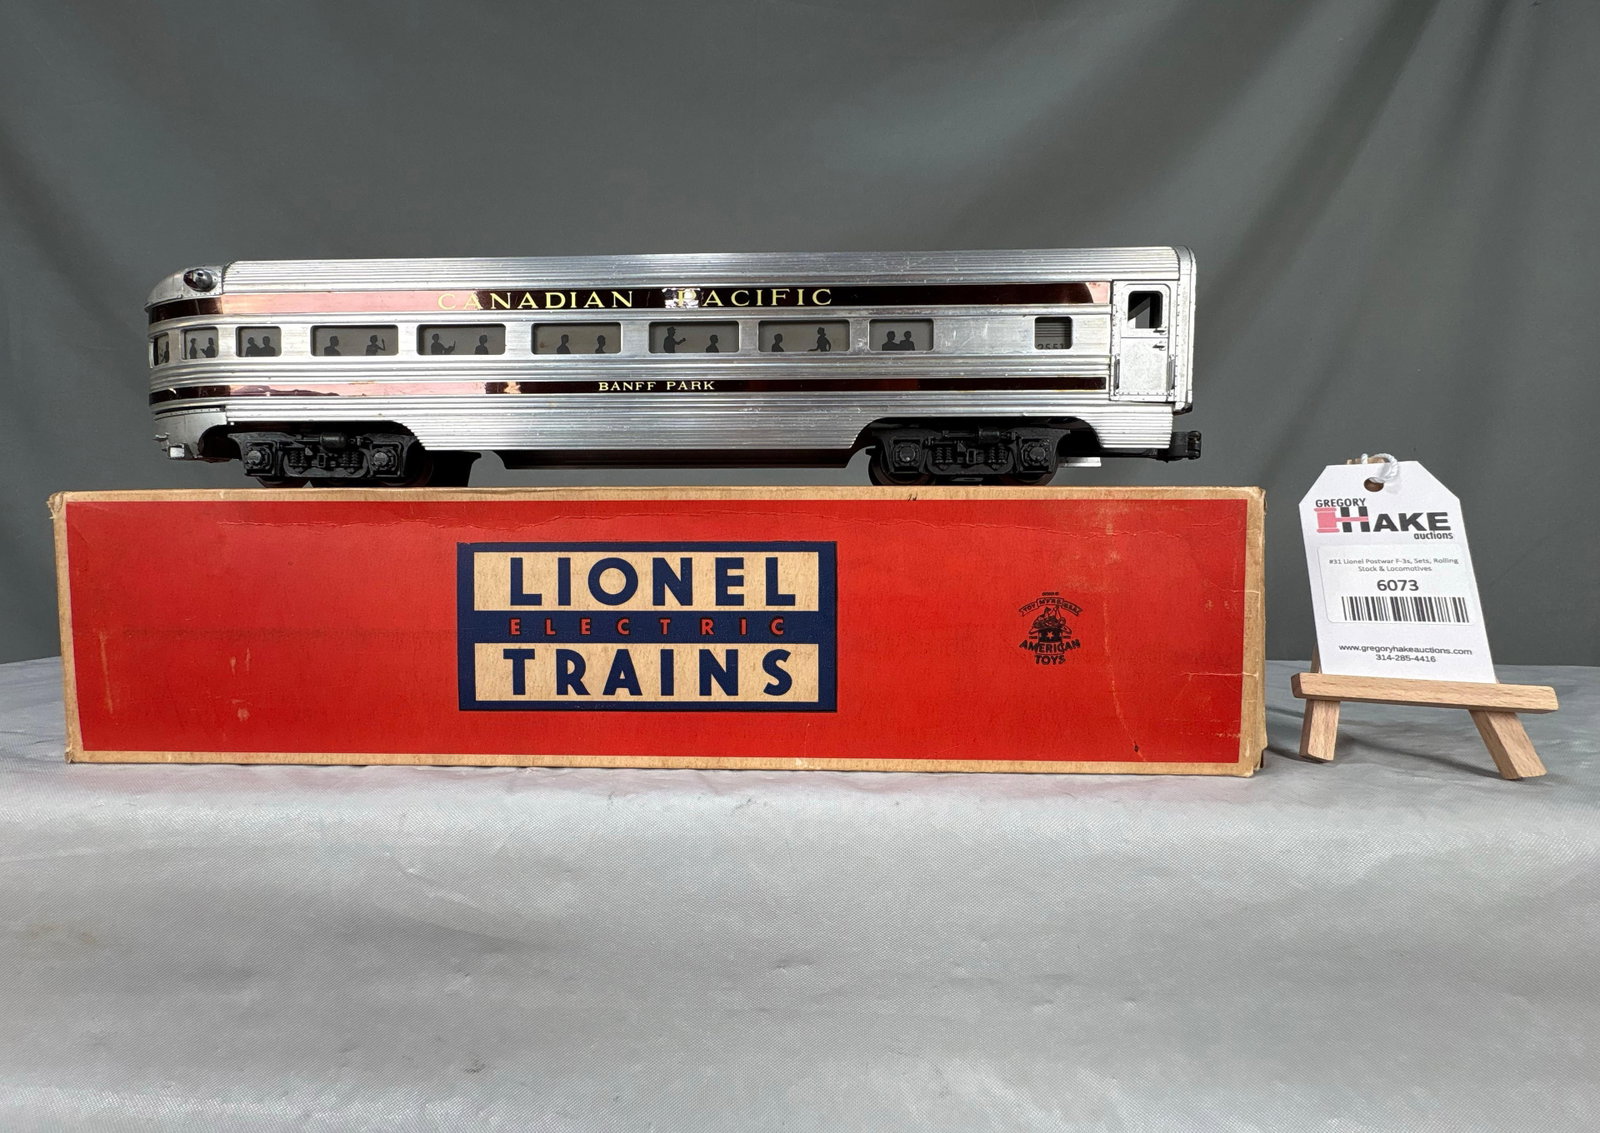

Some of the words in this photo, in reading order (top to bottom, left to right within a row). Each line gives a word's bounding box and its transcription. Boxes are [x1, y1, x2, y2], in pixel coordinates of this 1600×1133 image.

[437, 290, 633, 310] CANADIAN
[676, 288, 833, 308] PACIFIC
[598, 381, 657, 391] BANFF
[666, 381, 715, 391] PARK
[1315, 498, 1366, 507] GREGORY
[1340, 506, 1451, 532] HAKE
[1414, 531, 1454, 540] auctions
[1414, 558, 1432, 566] Sets,
[1433, 558, 1459, 566] Rolling
[509, 557, 796, 607] LIONEL
[1377, 579, 1419, 592] 6073
[510, 618, 786, 636] ELECTRIC
[1019, 639, 1081, 653] AMERICAN
[1338, 644, 1473, 656] www.gregoryhakeauctions.com
[1035, 654, 1066, 665] TOYS
[1375, 653, 1437, 663] 314-285-4416
[503, 649, 793, 696] TRAINS
